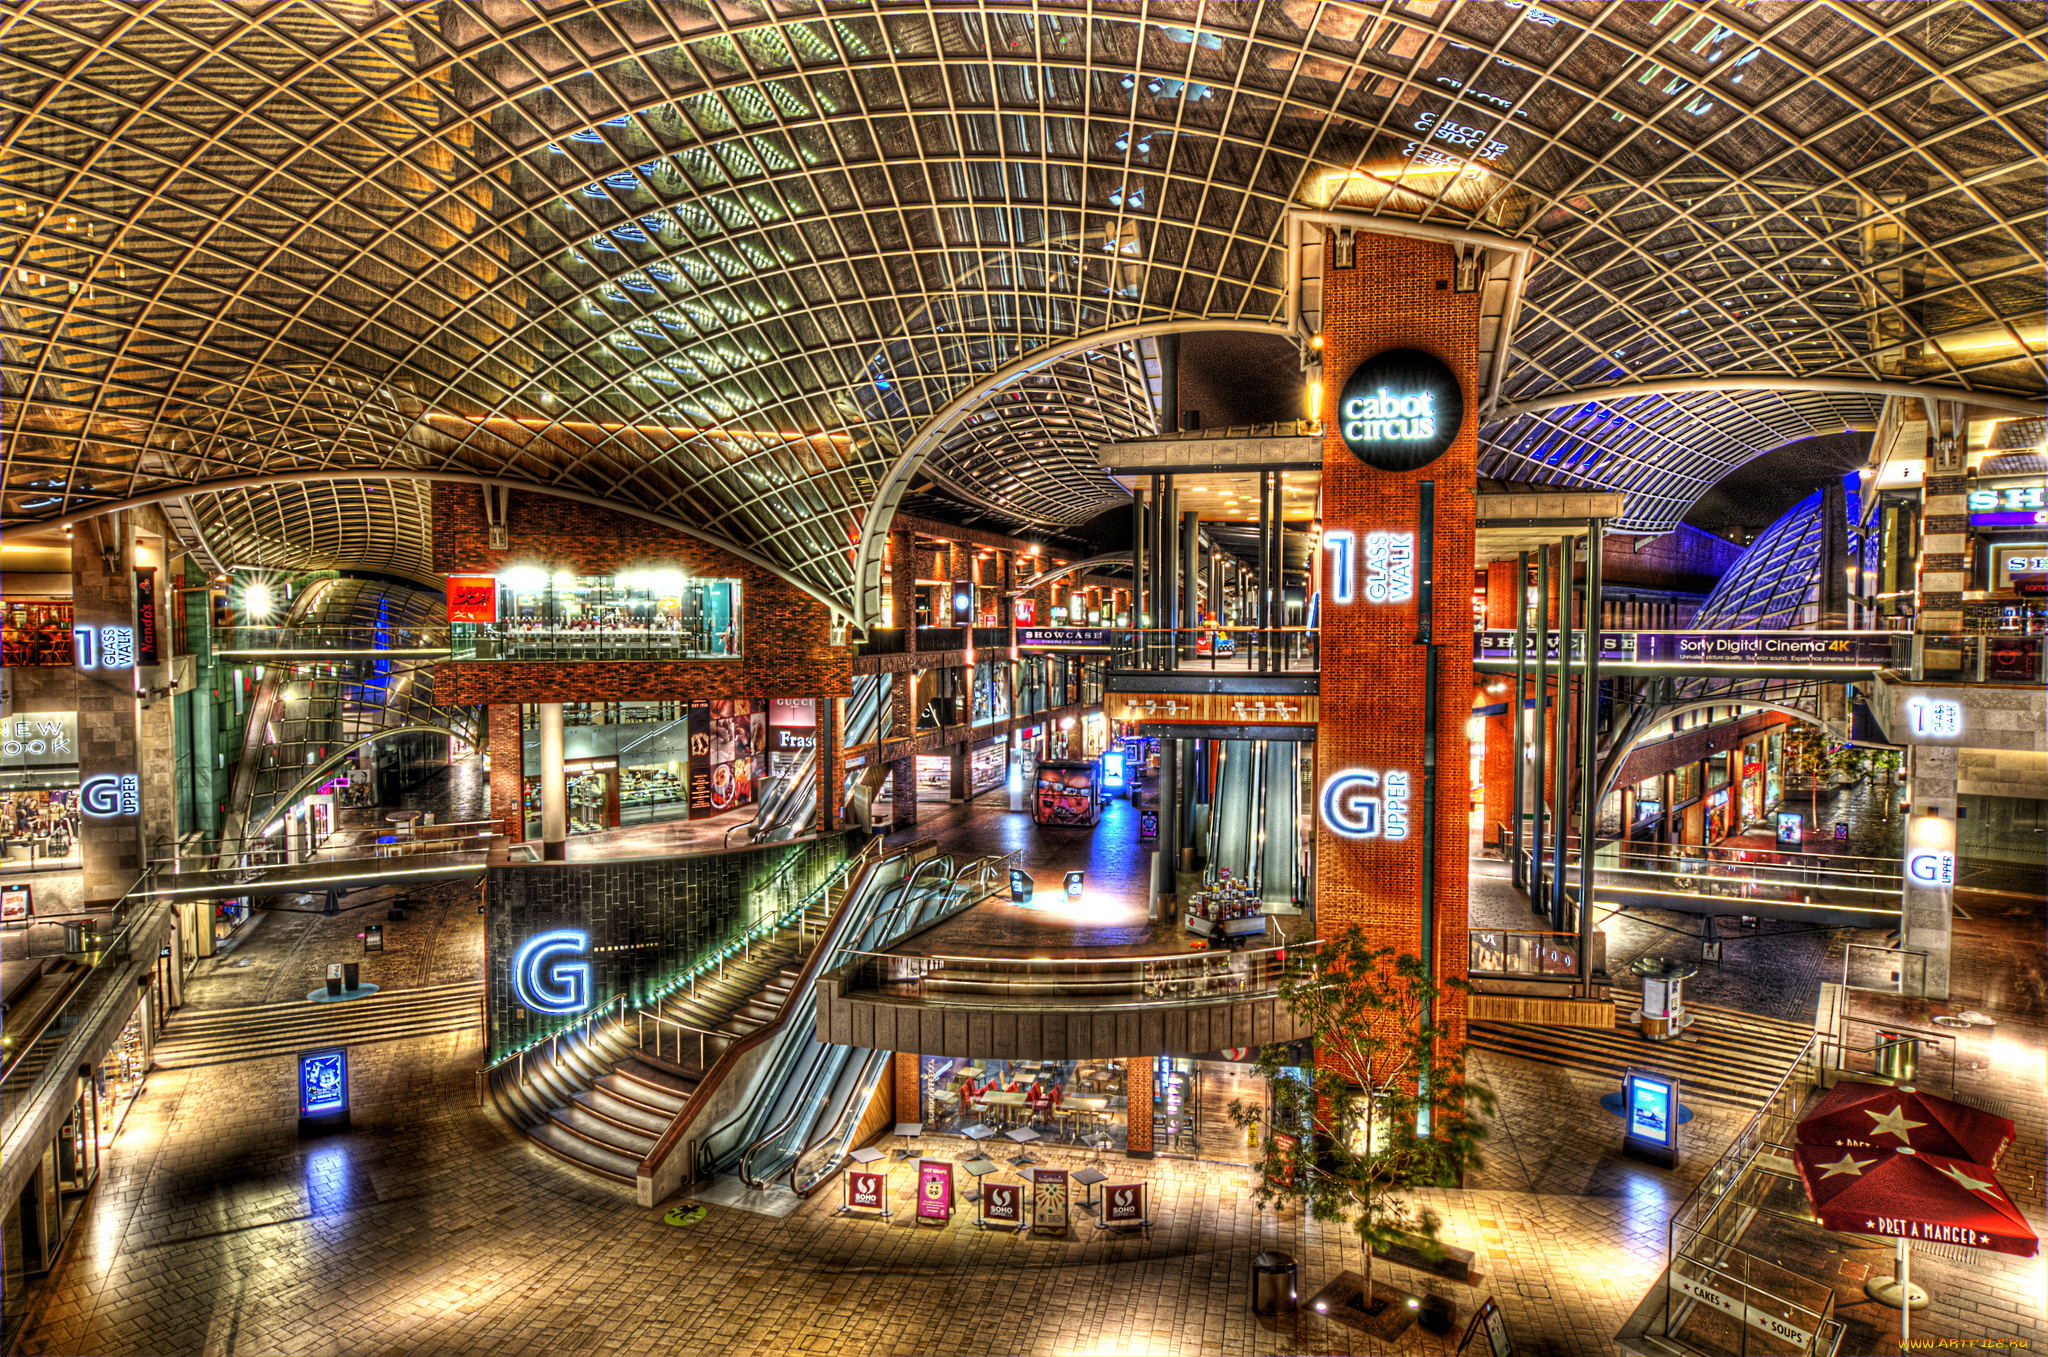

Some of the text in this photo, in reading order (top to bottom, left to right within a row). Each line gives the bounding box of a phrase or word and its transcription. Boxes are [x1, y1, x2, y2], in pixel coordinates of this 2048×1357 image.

[1345, 387, 1434, 419] cabot
[1344, 418, 1435, 441] circus
[1326, 535, 1351, 600] 1
[1369, 535, 1388, 600] GLASS
[1390, 535, 1411, 600] WALK
[140, 604, 155, 653] Nando's
[1025, 631, 1102, 639] SHOWCASE
[1680, 639, 1714, 652] Sony
[1717, 639, 1763, 653] Digital
[1829, 640, 1850, 651] 4K
[74, 628, 94, 668] 1
[102, 628, 117, 667] GLASS
[118, 629, 133, 667] WALK
[777, 698, 812, 706] GUCCI
[80, 777, 120, 816] G
[123, 776, 138, 815] UPPER
[1322, 771, 1379, 837] G
[1387, 773, 1407, 838] UPPER
[1910, 854, 1938, 881] G
[516, 931, 590, 1014] G
[855, 1193, 877, 1201] SOHO
[990, 1205, 1013, 1214] SOHO
[1112, 1205, 1136, 1214] SOHO
[1878, 1216, 1977, 1245] PRET A MANGER
[1693, 1286, 1720, 1306] CAKES
[1771, 1321, 1803, 1344] SOUPS
